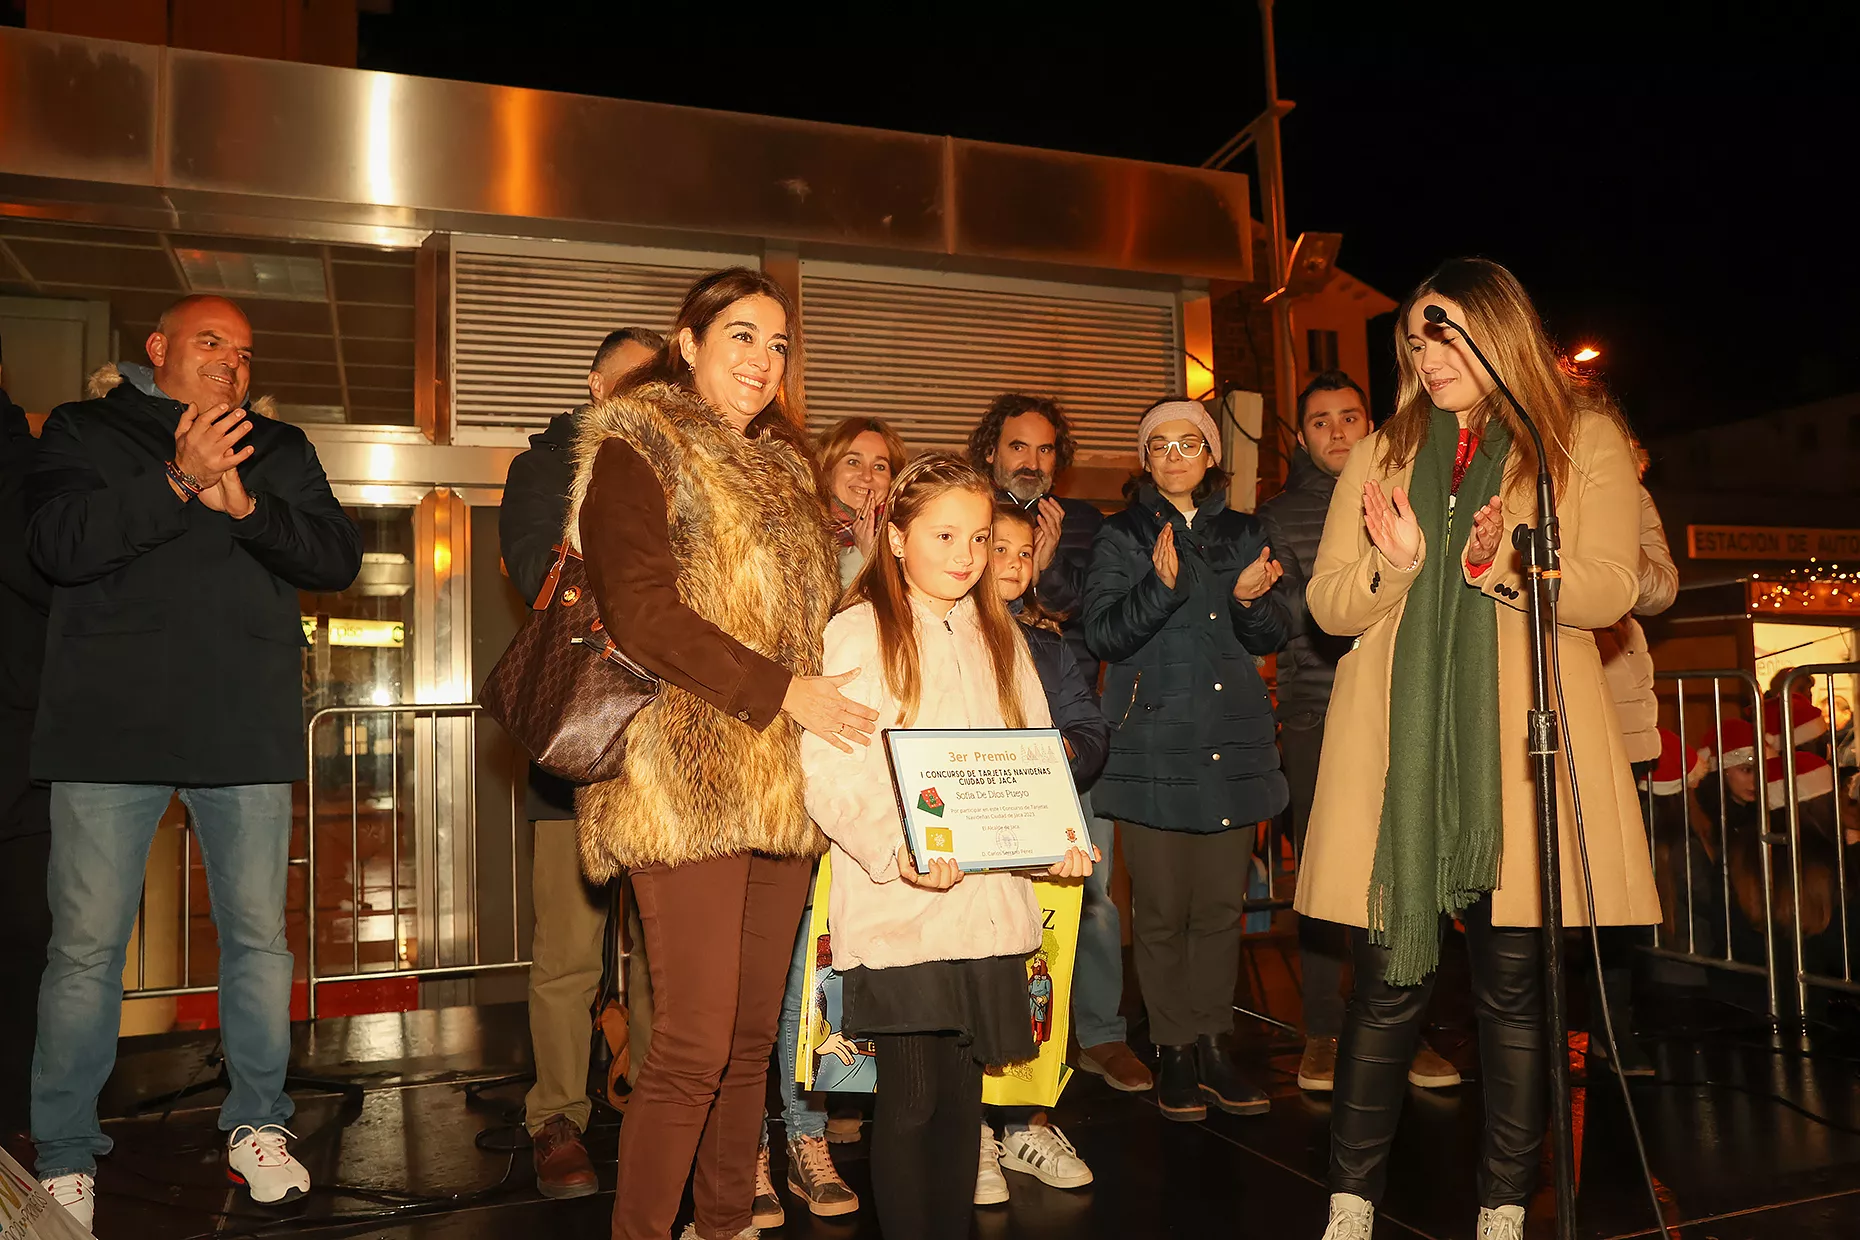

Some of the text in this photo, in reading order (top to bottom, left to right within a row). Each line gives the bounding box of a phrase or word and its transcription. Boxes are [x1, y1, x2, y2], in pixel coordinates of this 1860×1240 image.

[1787, 533, 1808, 553] DE
[948, 750, 1017, 762] 3er Premio
[920, 767, 1051, 779] I CONCURSO DE TARJETAS NAVIDEÑAS
[958, 776, 1017, 786] CIUDAD DE JACA
[977, 790, 988, 799] De
[988, 790, 1005, 799] Dios
[1005, 789, 1030, 800] Pueyo
